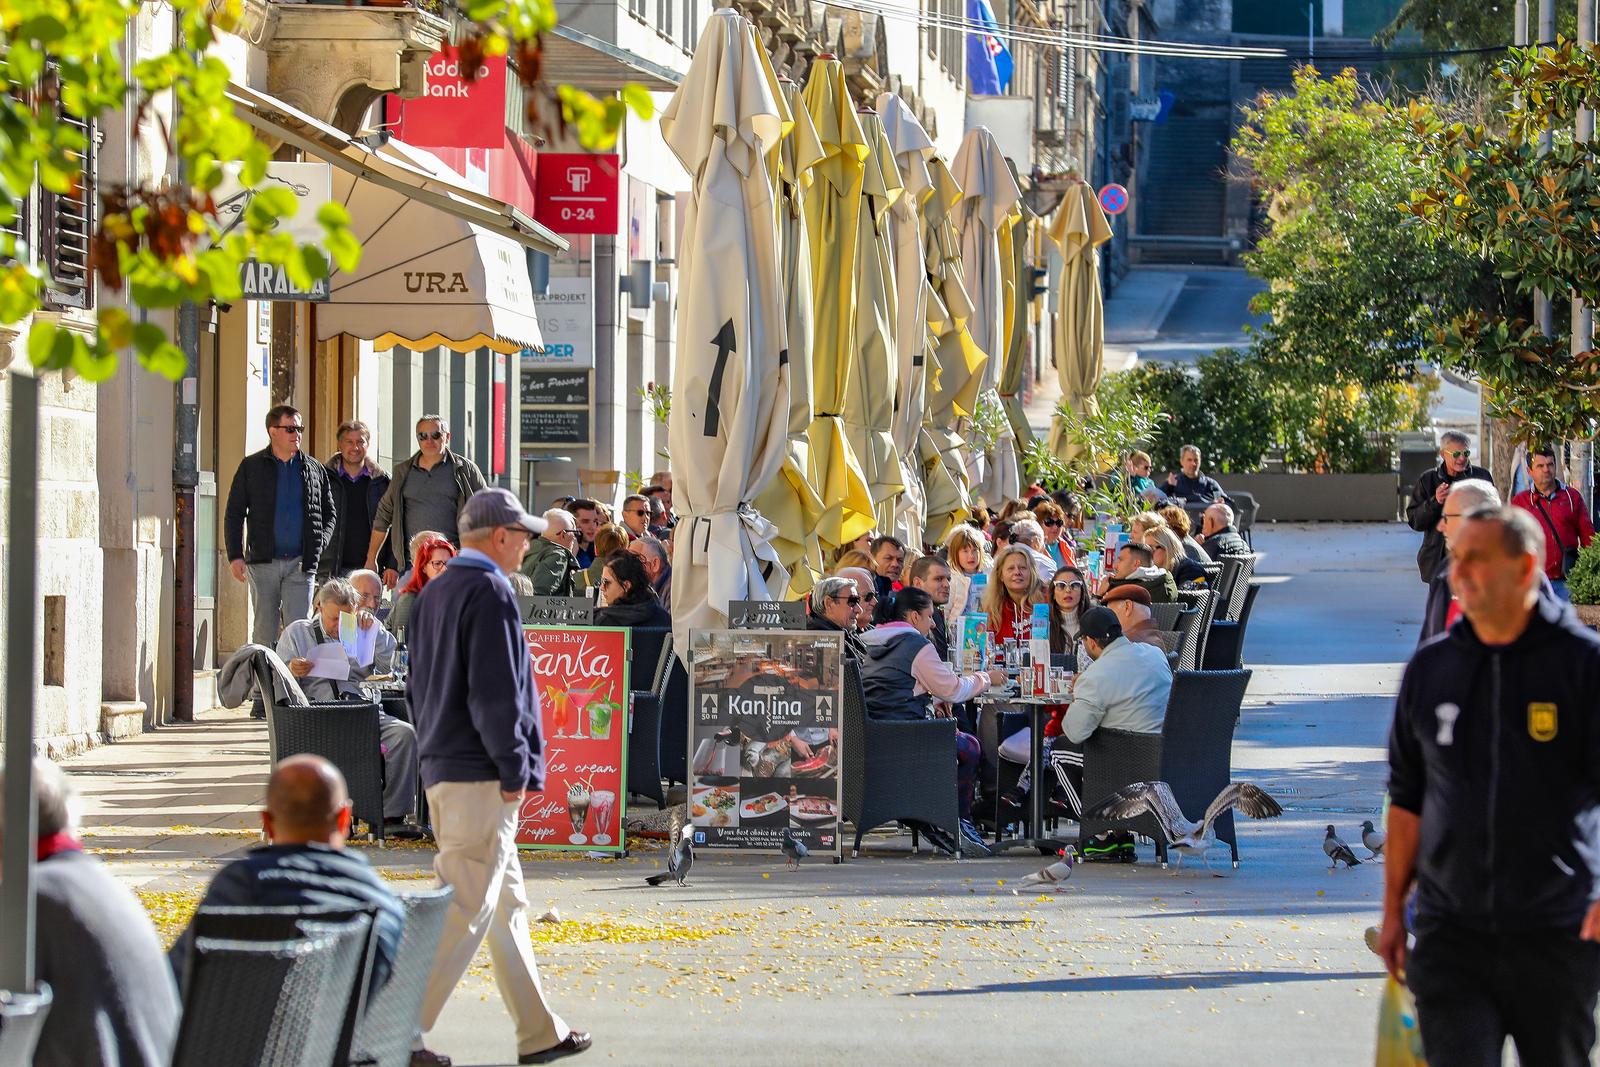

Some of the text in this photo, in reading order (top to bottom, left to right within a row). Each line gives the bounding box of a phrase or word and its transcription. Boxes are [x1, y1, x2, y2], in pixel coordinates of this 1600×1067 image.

[561, 207, 595, 221] 0-24
[404, 272, 468, 293] URA
[549, 293, 586, 302] PROJEKT
[759, 602, 780, 611] 1828
[544, 748, 617, 774] Ice cream
[521, 794, 566, 819] Coffee
